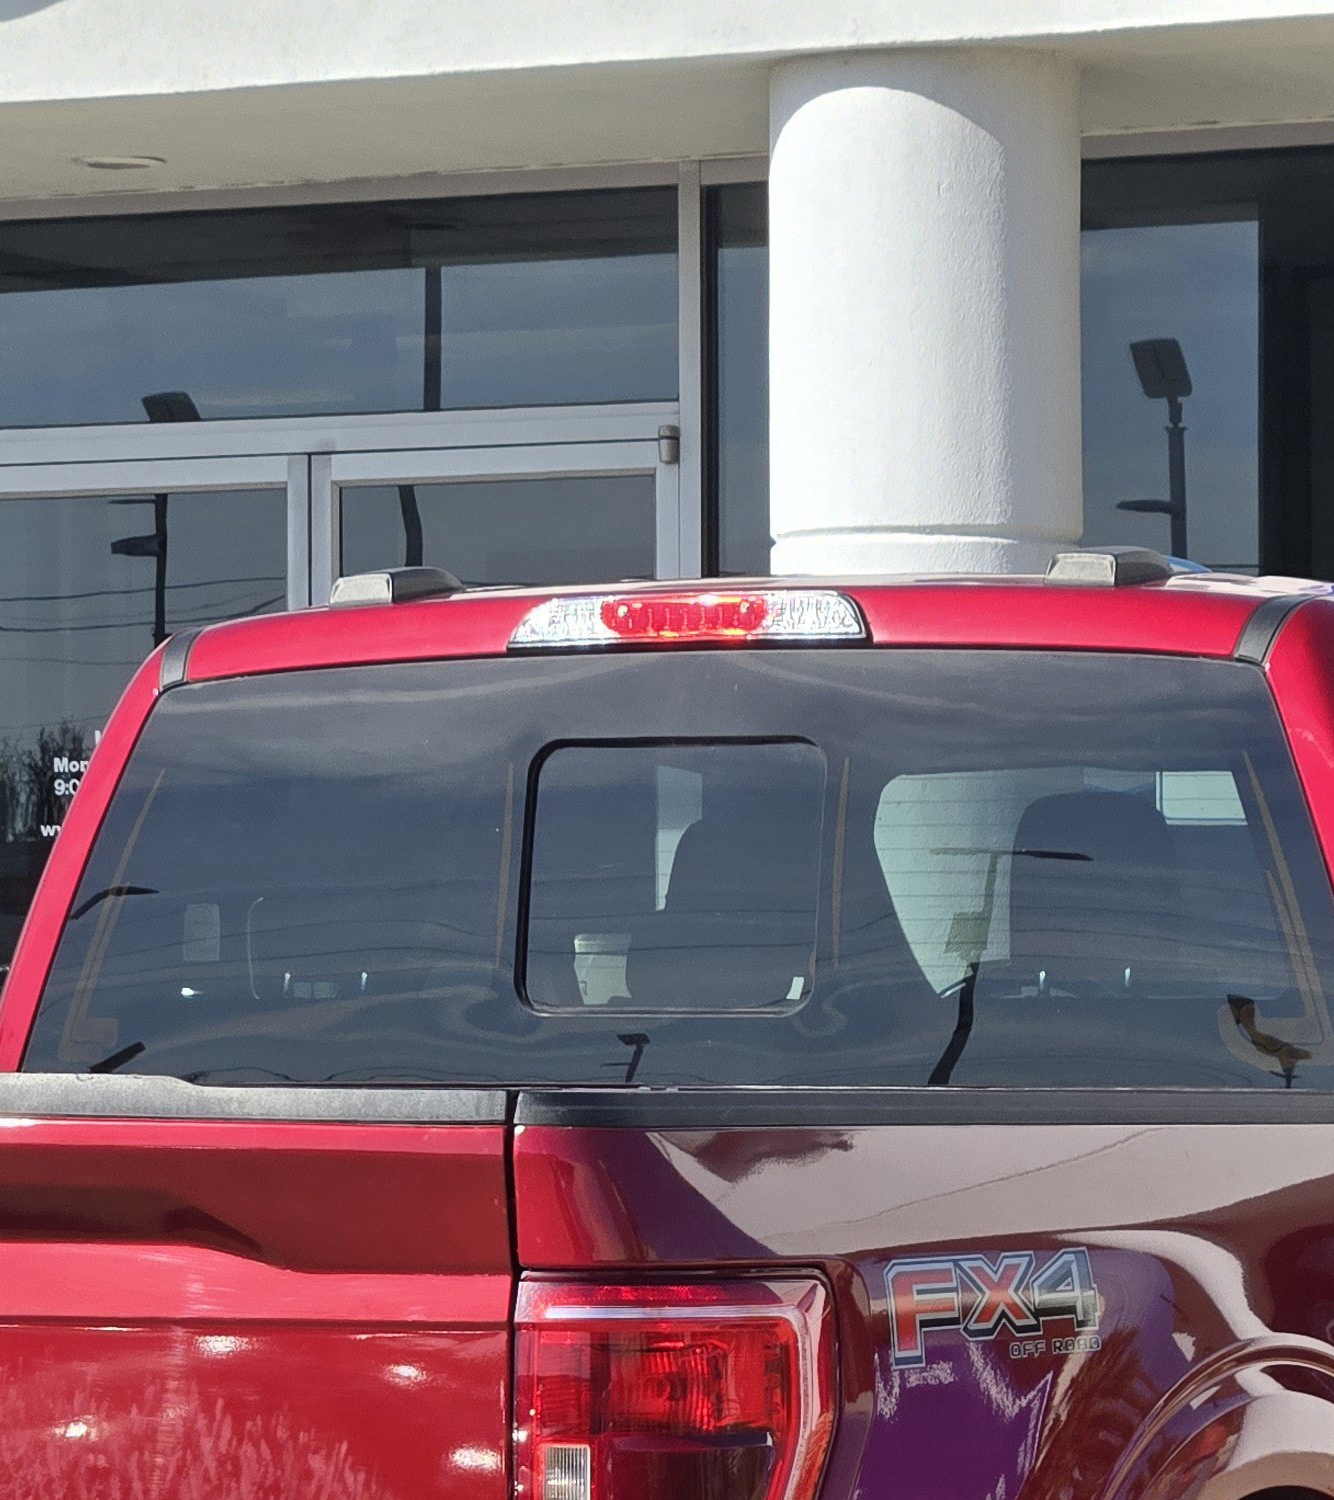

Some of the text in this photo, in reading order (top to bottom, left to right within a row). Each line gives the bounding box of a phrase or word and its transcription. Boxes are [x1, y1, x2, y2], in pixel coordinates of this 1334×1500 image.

[884, 1247, 1099, 1370] FX4
[1010, 1336, 1101, 1359] OFF ROAD
